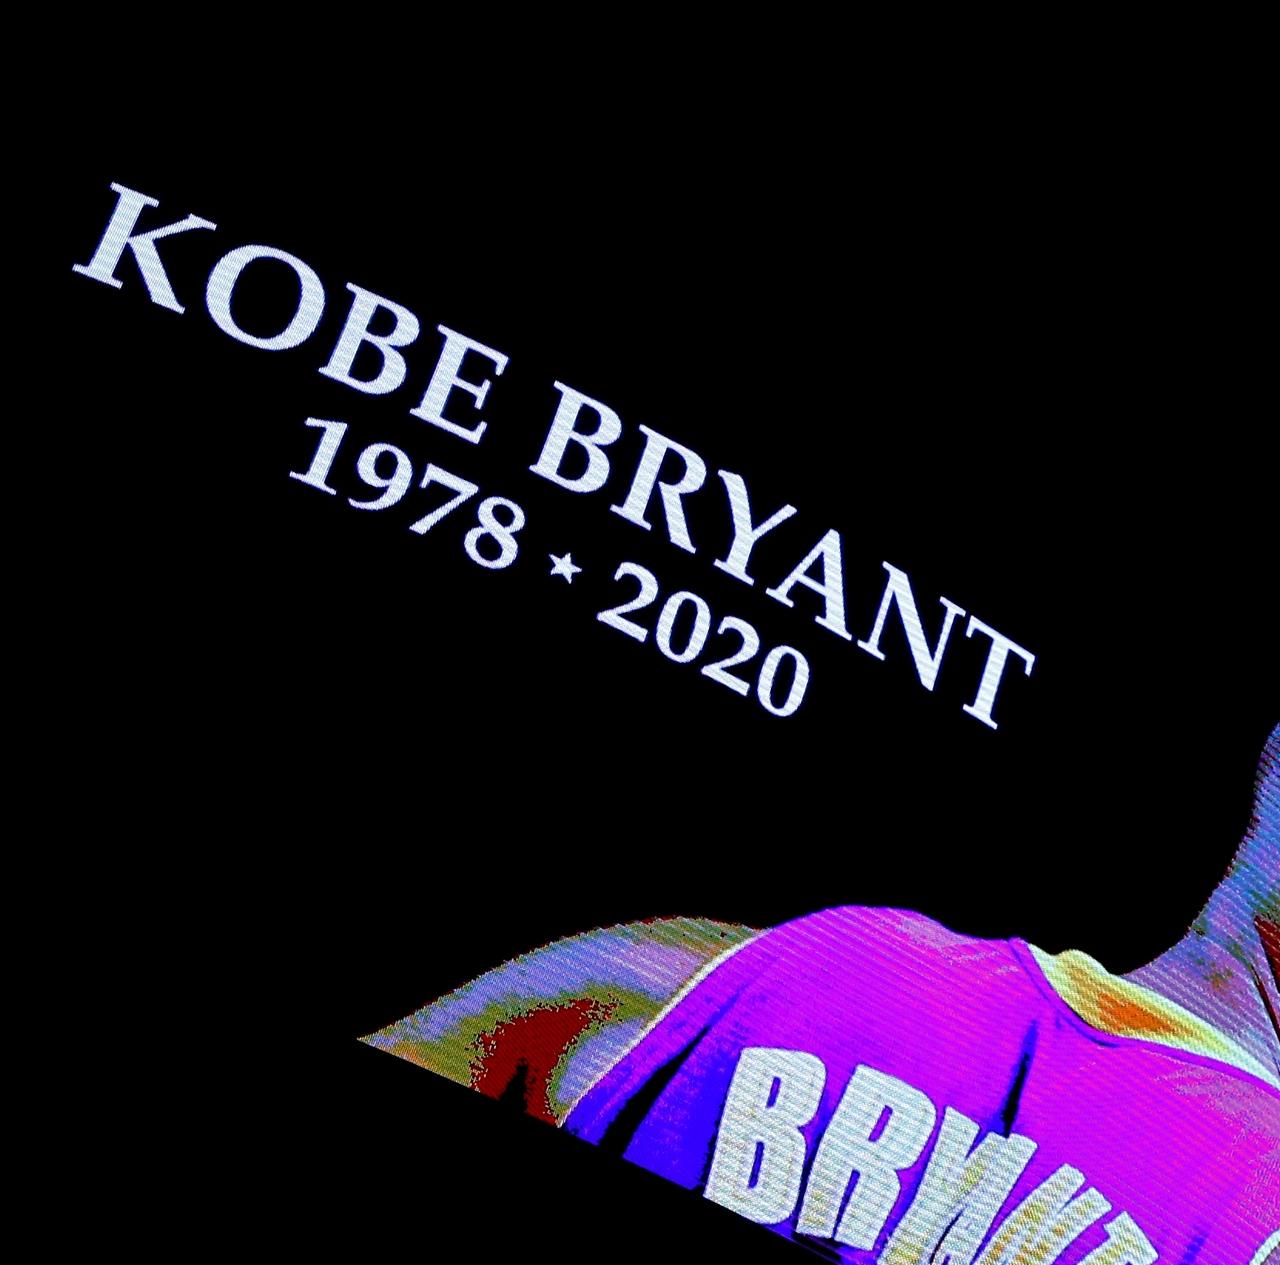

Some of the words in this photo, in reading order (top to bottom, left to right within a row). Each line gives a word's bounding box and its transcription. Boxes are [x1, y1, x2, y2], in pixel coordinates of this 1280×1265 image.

[71, 181, 510, 446] KOBE
[528, 379, 1036, 731] BRYANT
[289, 415, 527, 570] 1978
[595, 560, 811, 718] 2020
